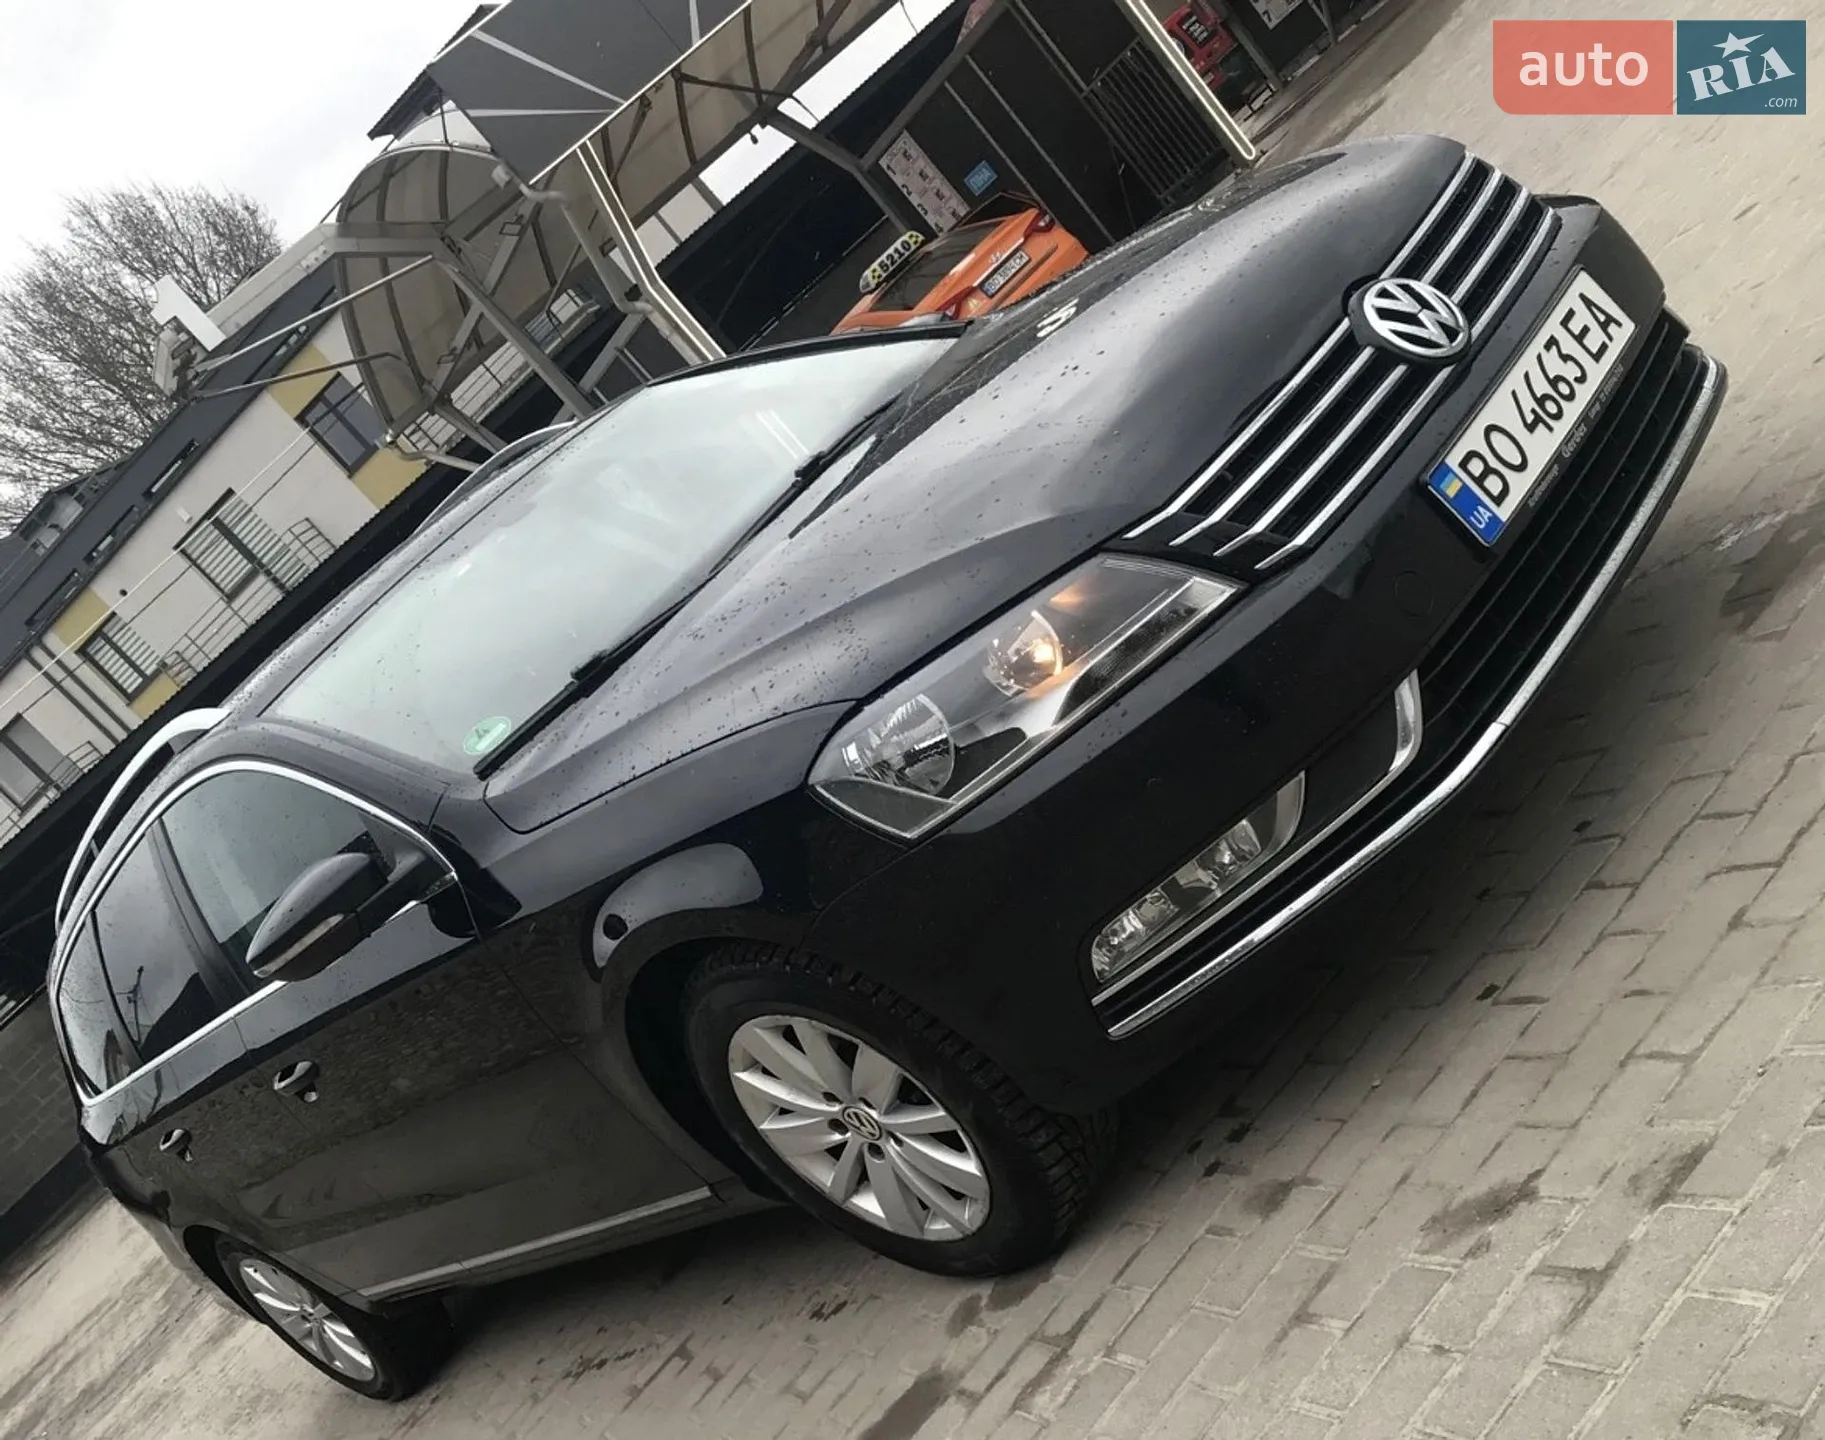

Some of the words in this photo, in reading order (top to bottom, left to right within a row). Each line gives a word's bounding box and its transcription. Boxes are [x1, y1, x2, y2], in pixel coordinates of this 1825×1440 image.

[901, 183, 913, 197] 2
[917, 203, 929, 217] 3
[878, 240, 911, 273] 5210
[1458, 423, 1529, 508] BO
[1511, 335, 1588, 434] 4663
[1559, 292, 1623, 364] EA
[1469, 505, 1494, 529] UA
